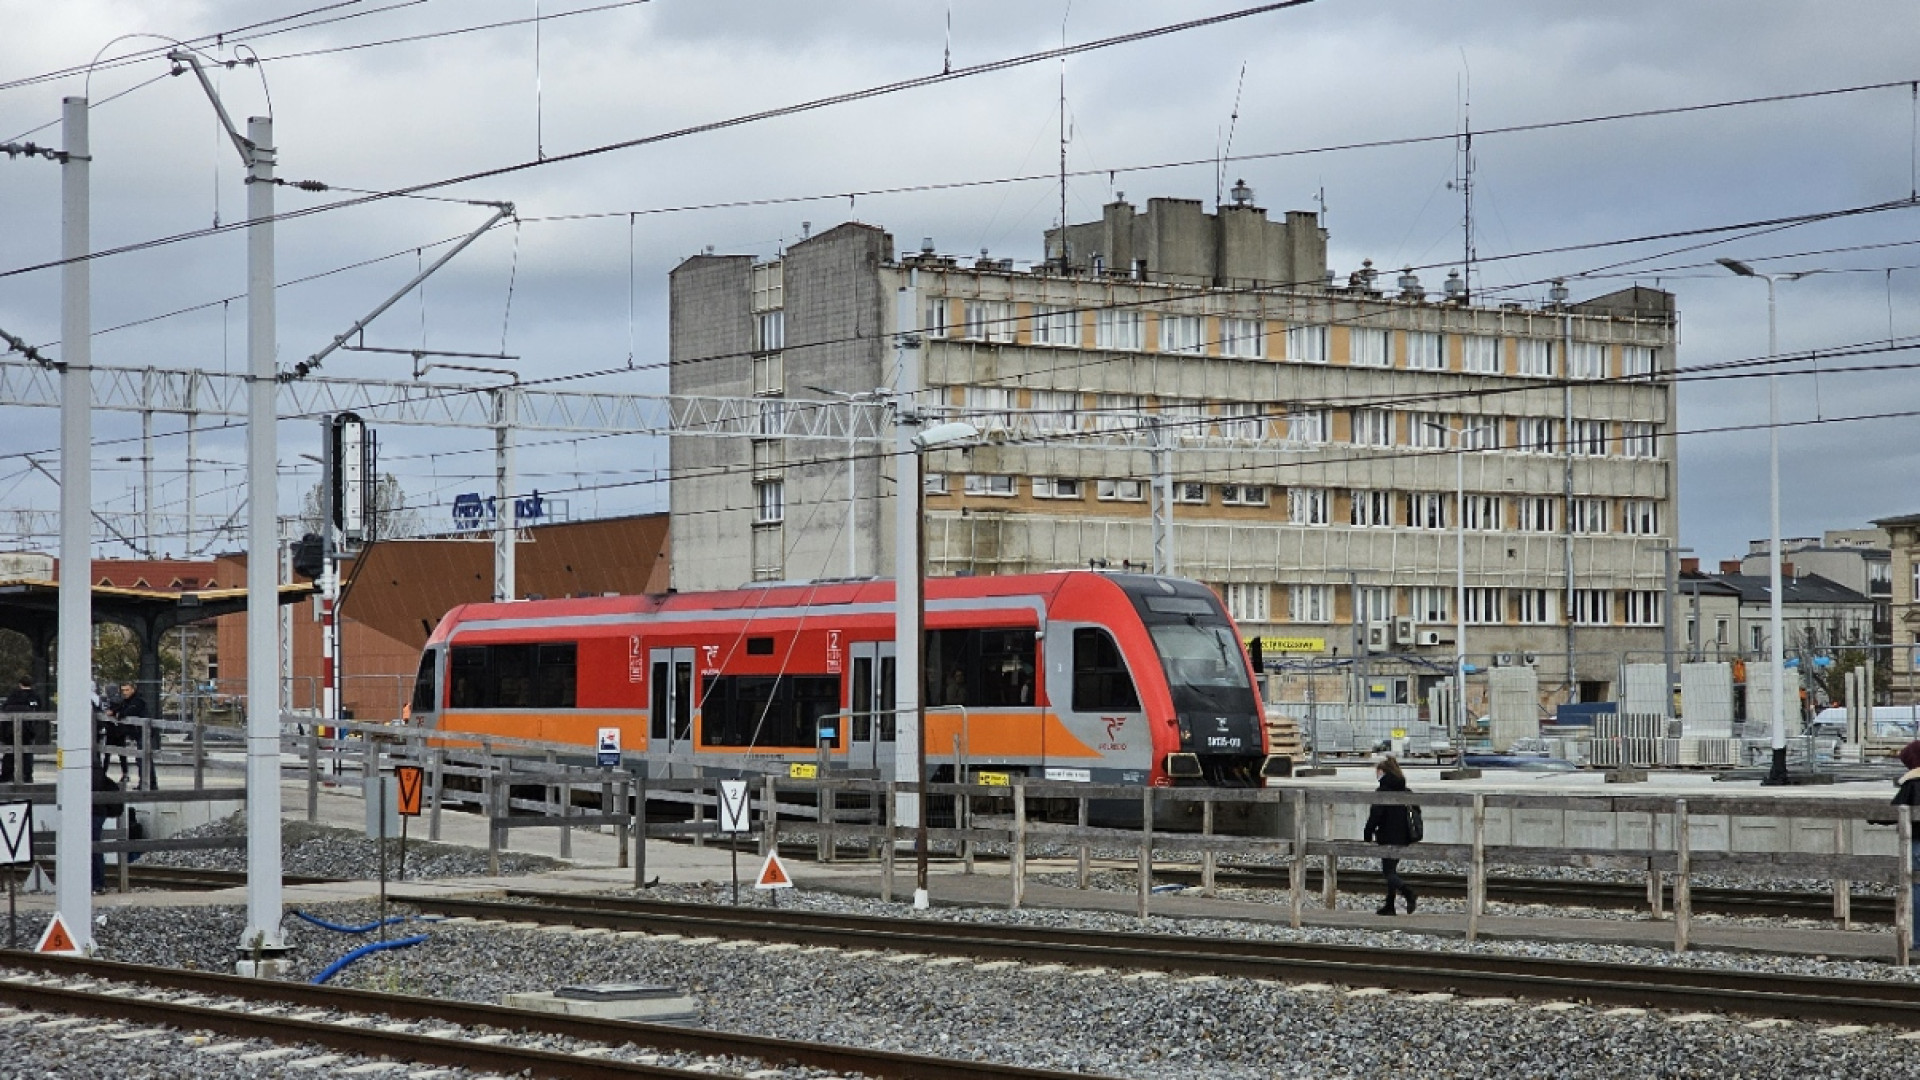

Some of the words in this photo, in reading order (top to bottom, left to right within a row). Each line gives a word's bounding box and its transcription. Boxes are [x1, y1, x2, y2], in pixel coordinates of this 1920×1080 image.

[633, 637, 640, 655] 2
[832, 633, 838, 649] 2
[731, 788, 738, 799] 2
[9, 812, 16, 823] 2
[771, 870, 776, 880] 5
[54, 935, 62, 946] 5
